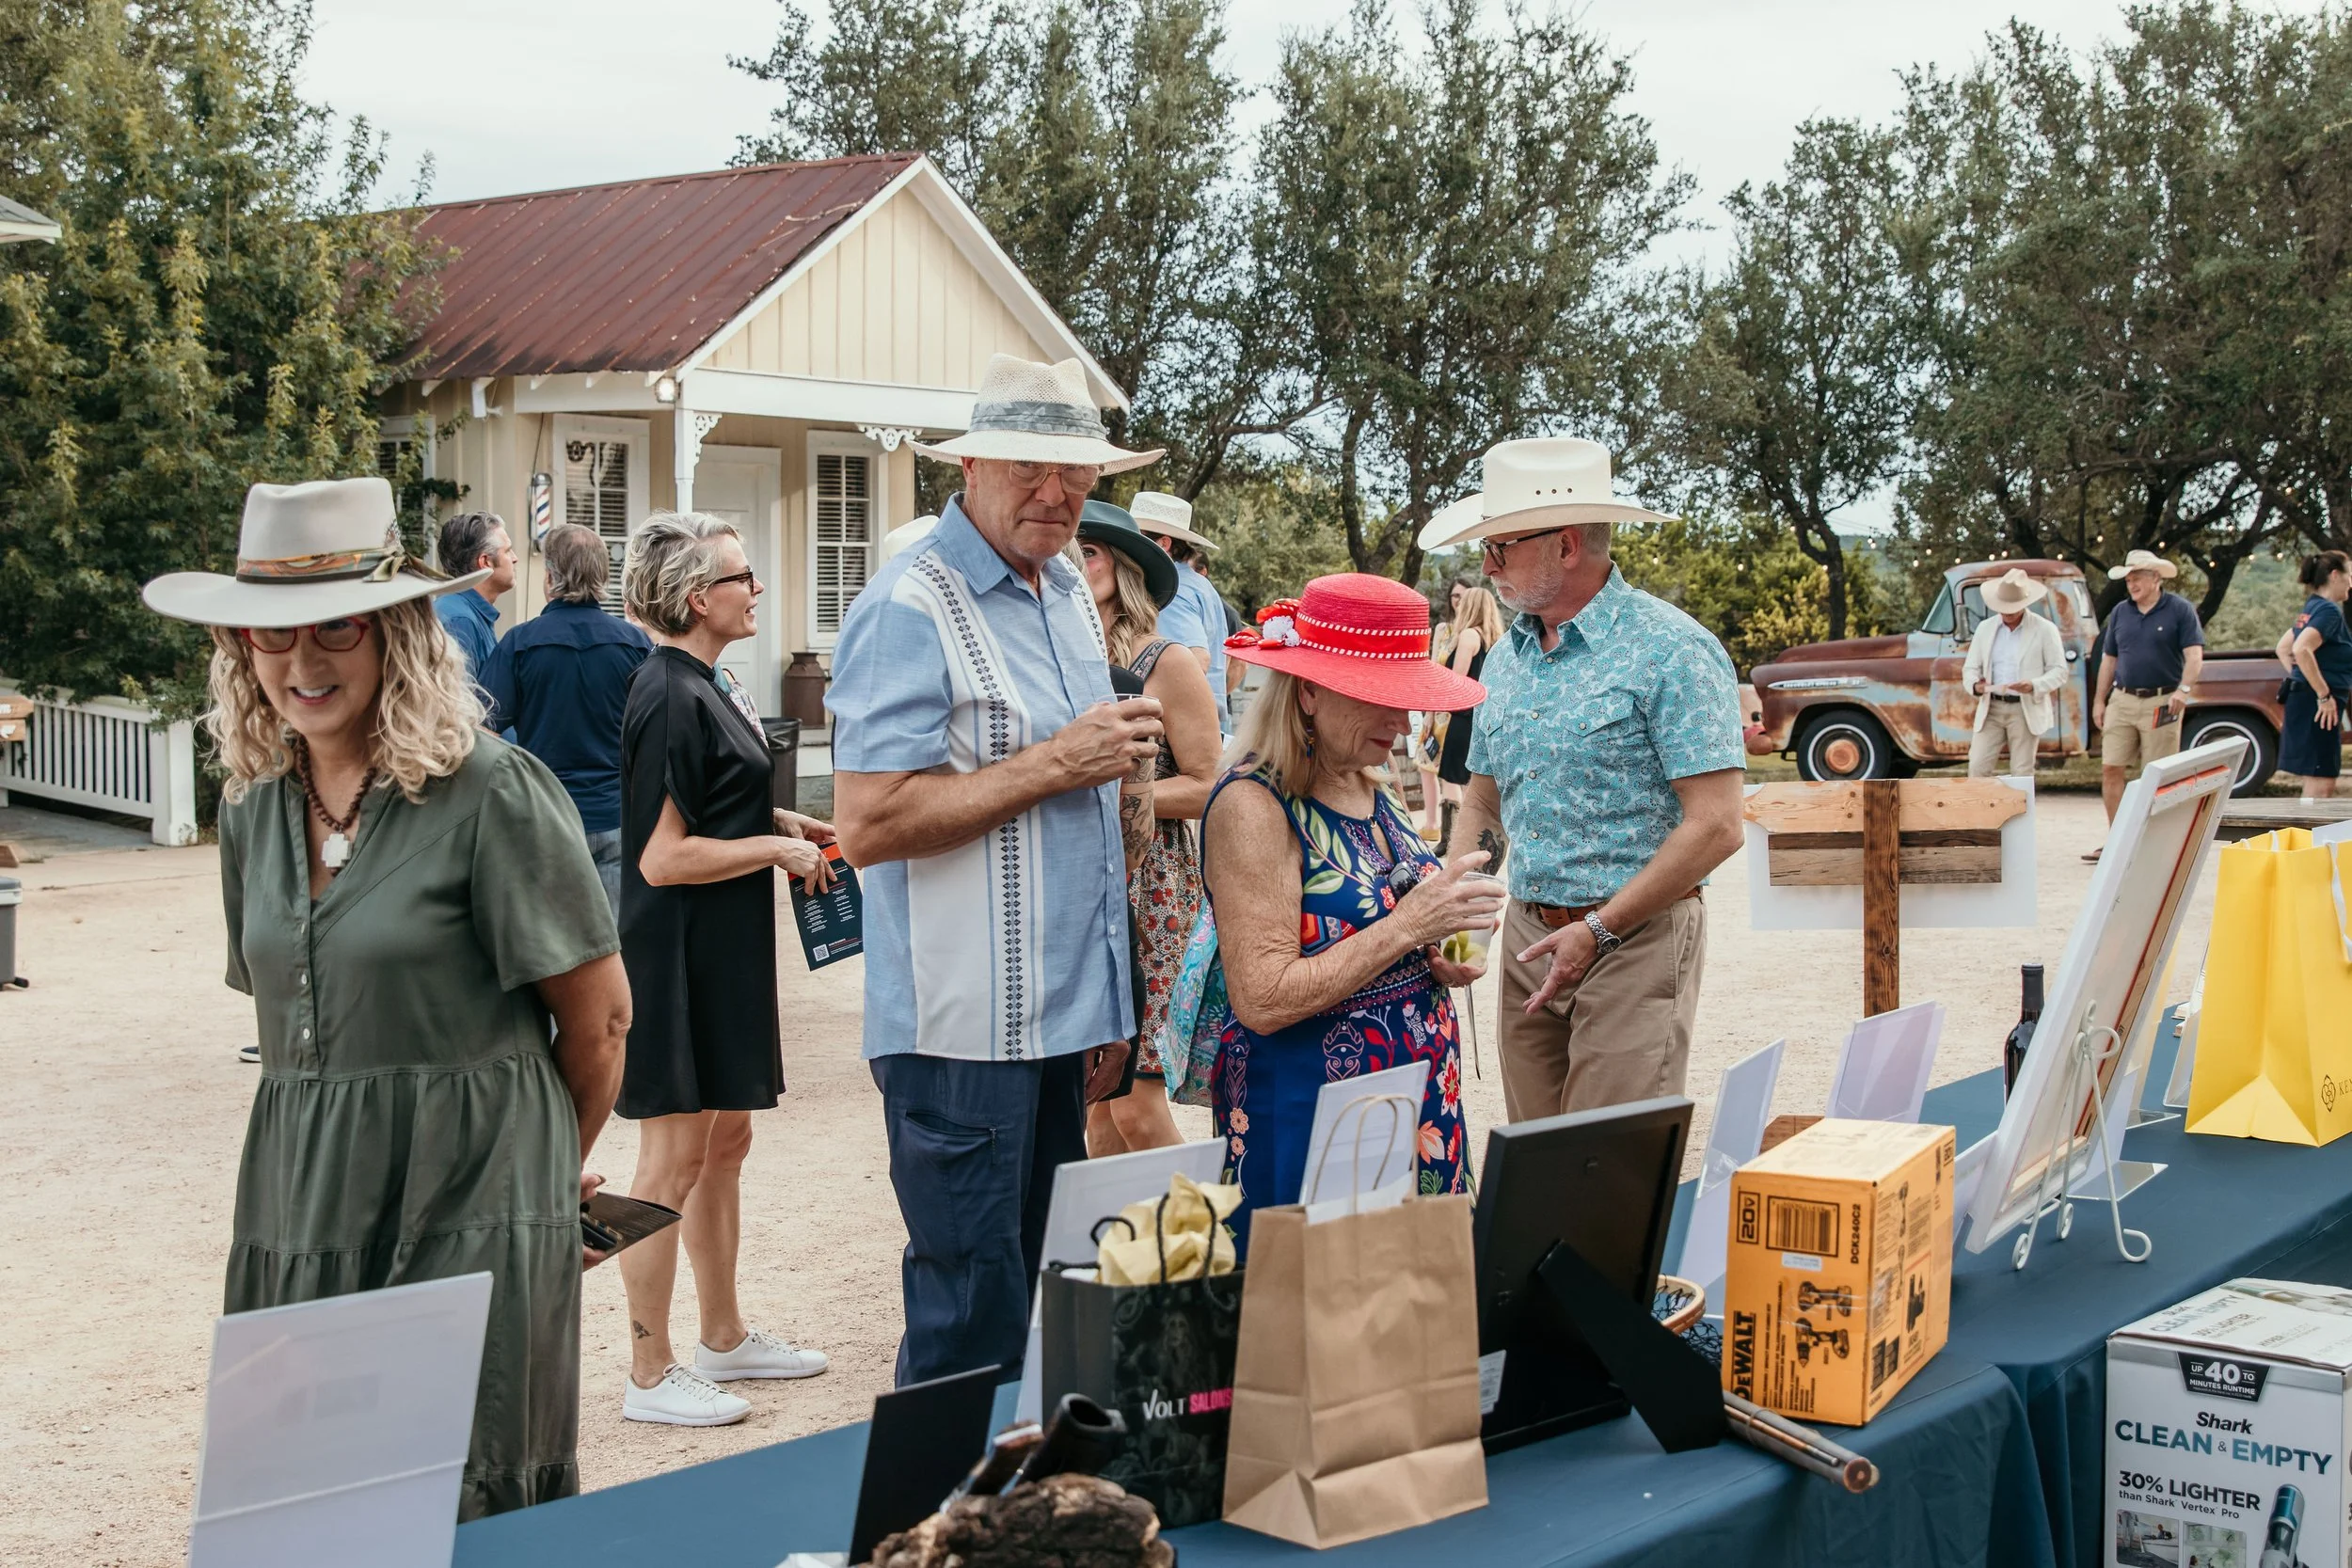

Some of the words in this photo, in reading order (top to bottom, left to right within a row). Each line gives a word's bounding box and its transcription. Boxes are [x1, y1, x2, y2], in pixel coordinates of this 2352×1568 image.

[1851, 1204, 1861, 1264] DCK240C2
[2189, 1379, 2221, 1389] MINUTES
[2222, 1385, 2255, 1395] RUNTIME
[2191, 1364, 2203, 1372] UP
[2204, 1361, 2241, 1385] 40
[2242, 1372, 2254, 1381] TO
[2196, 1411, 2253, 1434] Shark
[2114, 1419, 2213, 1455] CLEAN
[2217, 1440, 2228, 1452] &
[2232, 1438, 2332, 1475] EMPTY
[2119, 1470, 2163, 1493] 30%
[2169, 1479, 2261, 1511] LIGHTER
[2119, 1490, 2142, 1501] than
[2145, 1494, 2175, 1508] Shark
[2181, 1500, 2216, 1514] Vertex
[2221, 1508, 2240, 1519] Pro
